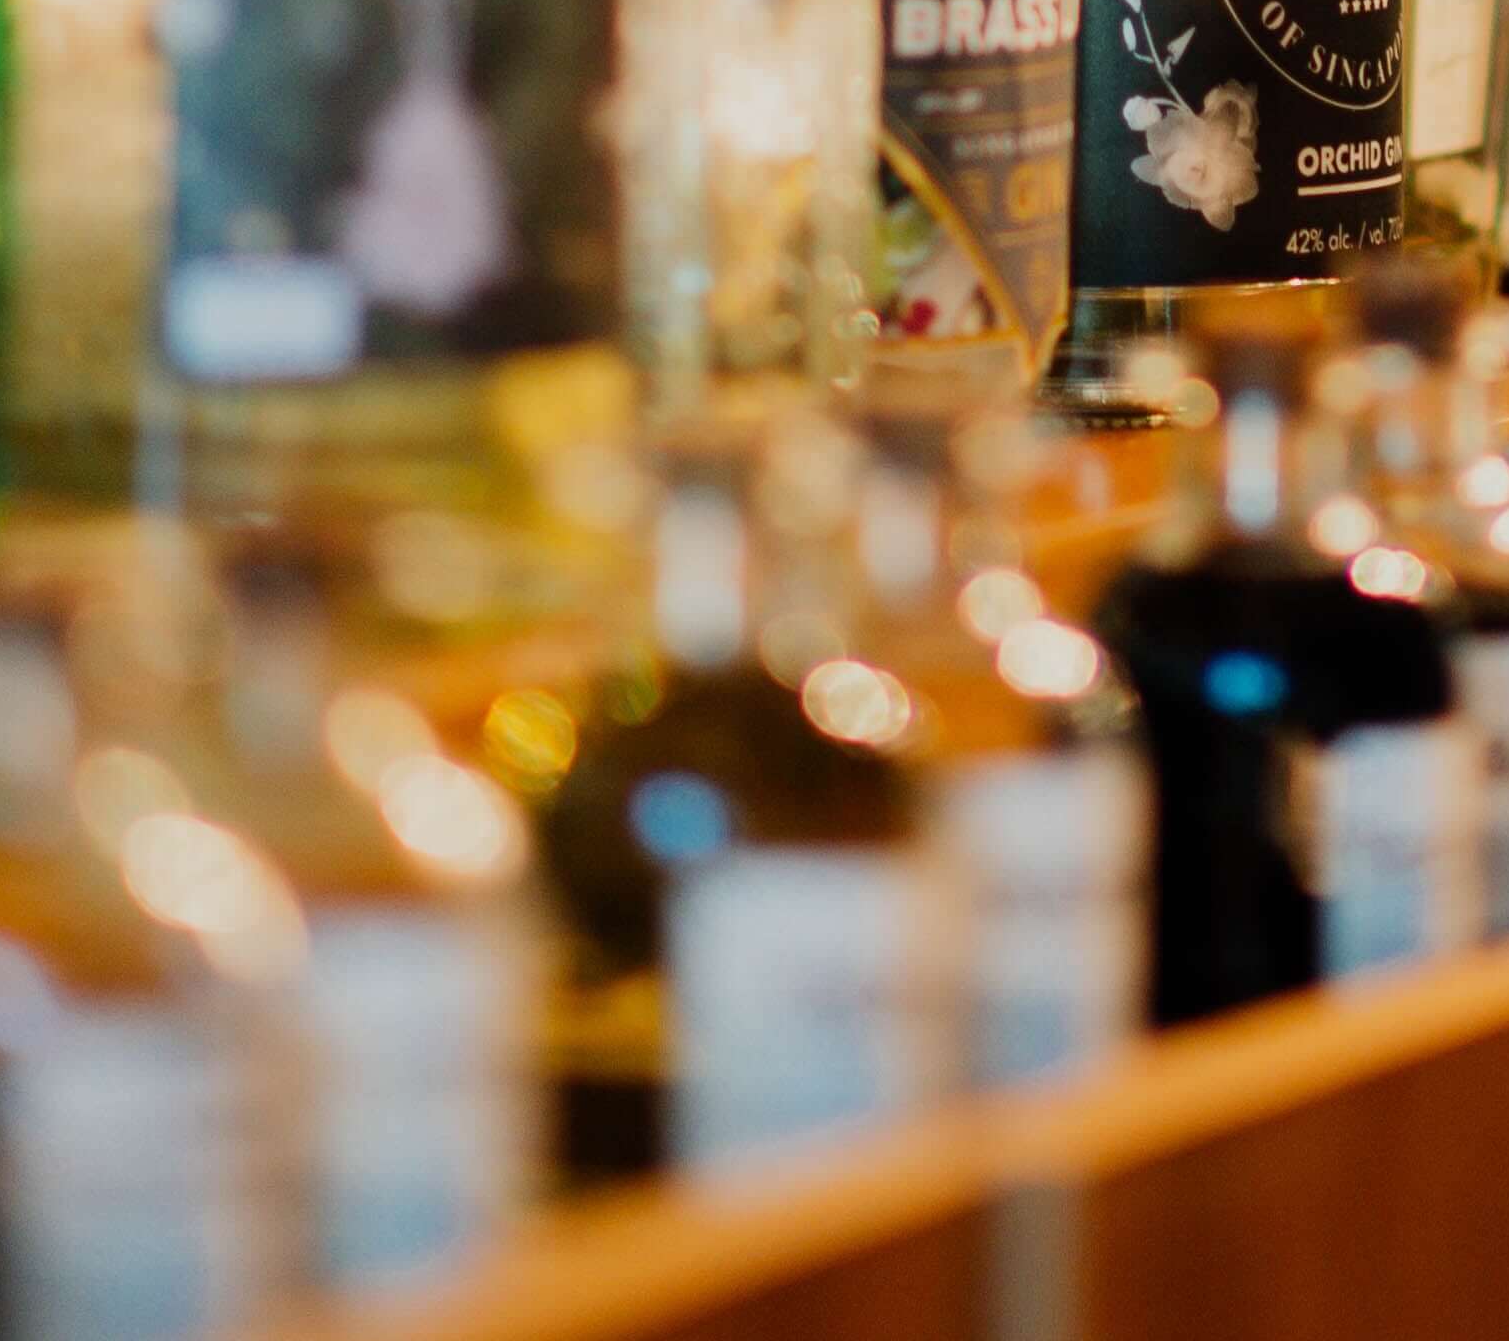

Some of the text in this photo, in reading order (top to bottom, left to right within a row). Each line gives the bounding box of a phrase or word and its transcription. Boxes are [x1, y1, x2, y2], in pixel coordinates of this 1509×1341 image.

[1260, 0, 1305, 49] OF
[1297, 139, 1381, 178] ORCHID
[1285, 228, 1325, 254] 42%
[1328, 222, 1354, 251] alc.
